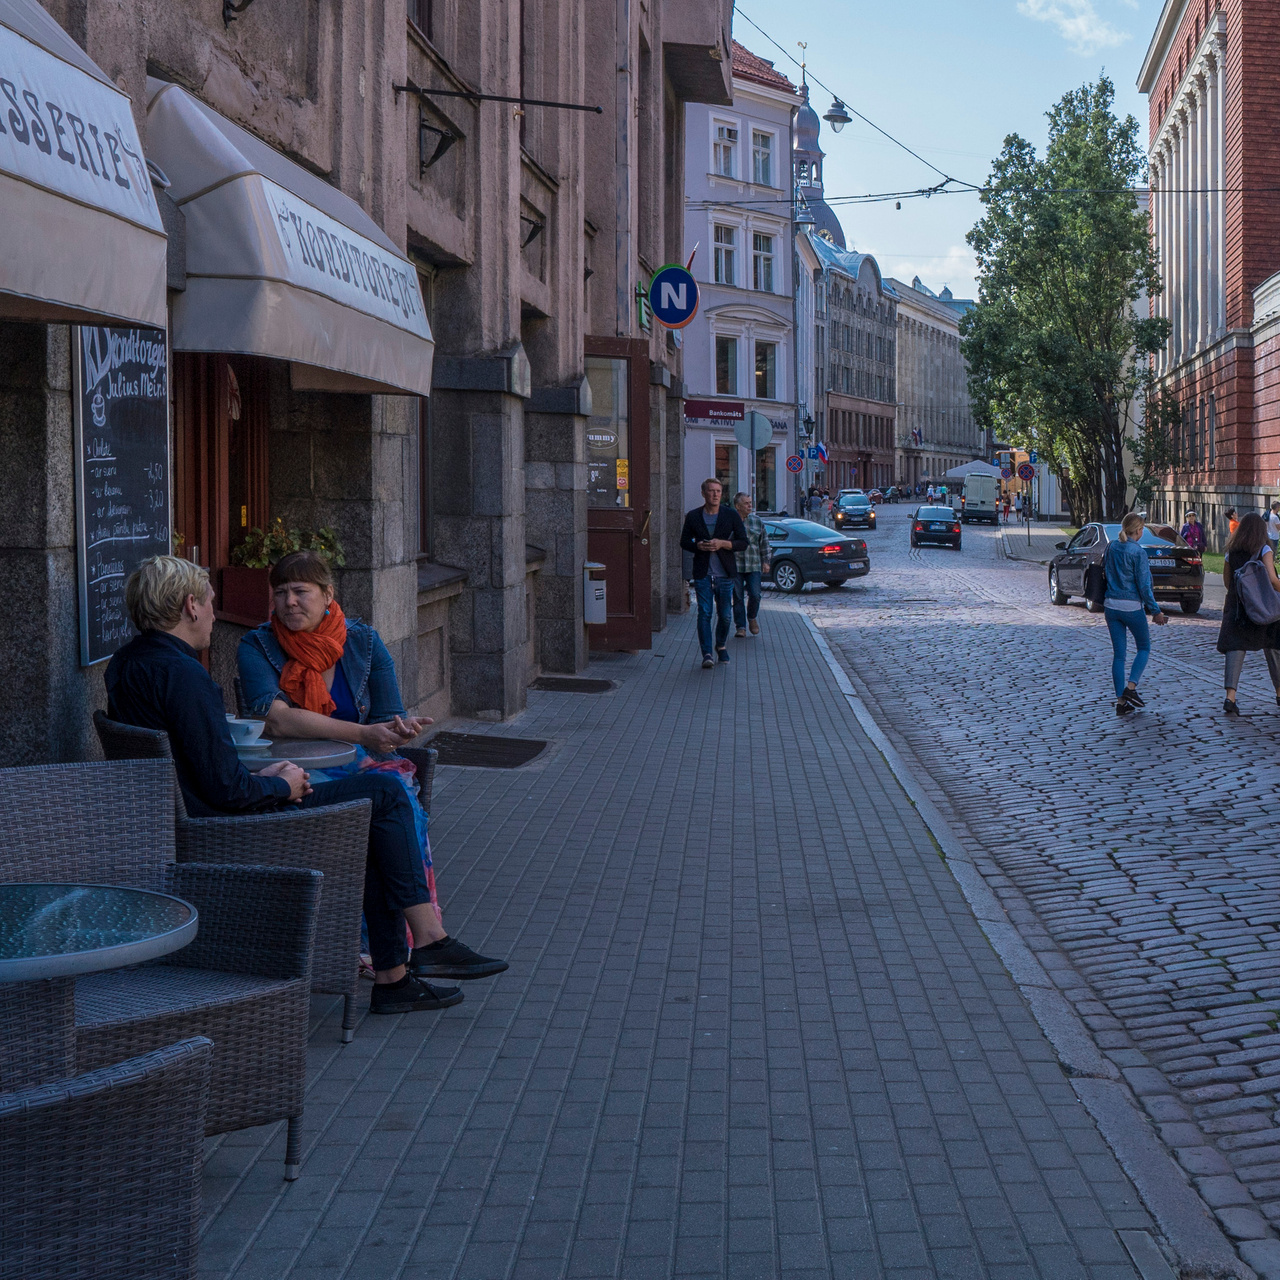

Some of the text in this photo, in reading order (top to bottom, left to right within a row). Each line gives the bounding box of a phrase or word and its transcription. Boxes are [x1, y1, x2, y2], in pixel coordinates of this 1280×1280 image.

[0, 77, 130, 190] SSERIE
[289, 210, 416, 320] KONDITOREJA
[661, 282, 687, 310] N
[106, 371, 167, 400] Julius Meinl
